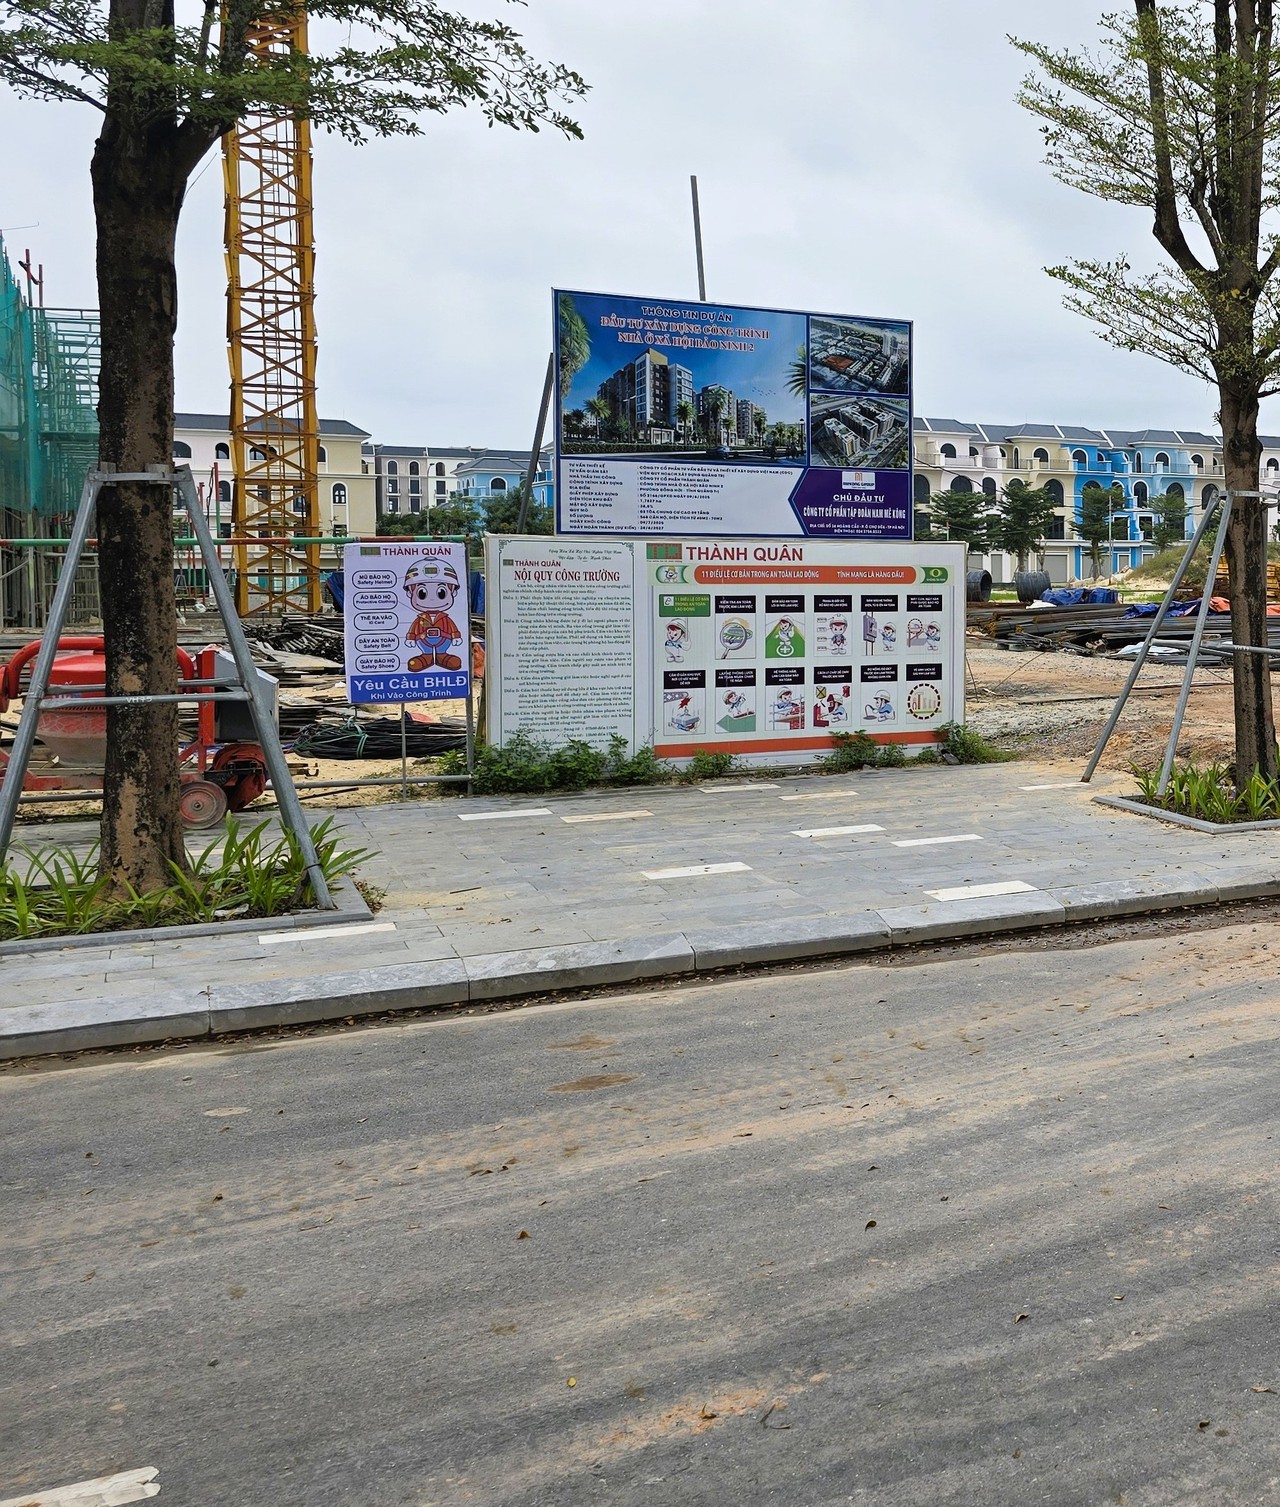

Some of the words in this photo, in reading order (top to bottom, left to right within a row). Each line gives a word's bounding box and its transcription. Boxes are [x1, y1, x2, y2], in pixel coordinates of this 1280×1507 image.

[642, 306, 680, 318] THÔNG
[682, 310, 698, 319] TIN
[701, 312, 716, 323] DỰ
[718, 311, 732, 322] ÁN
[601, 313, 626, 328] ĐẦU
[627, 318, 643, 329] TƯ
[645, 320, 668, 331] XÂY
[669, 322, 701, 335] DỰNG
[703, 324, 734, 336] CÔNG
[736, 327, 770, 339] TRÌNH
[618, 331, 644, 343] NHÀ
[645, 331, 654, 344] Ở
[655, 334, 671, 345] XÃ
[672, 335, 694, 349] HỘI
[696, 337, 718, 348] BẢO
[720, 340, 747, 351] NINH
[748, 343, 755, 352] 2
[833, 493, 851, 502] CHỦ
[854, 493, 872, 502] ĐẦU
[803, 505, 817, 516] CÔNG
[818, 508, 824, 516] TY
[826, 504, 832, 517] CỔ
[833, 505, 847, 517] PHẦN
[848, 507, 857, 519] TẬP
[858, 506, 871, 518] ĐOÀN
[872, 509, 883, 518] NAM
[884, 508, 891, 518] MÊ
[893, 508, 906, 518] KÔNG
[383, 546, 418, 556] THÀNH
[422, 546, 451, 556] QUÂN
[686, 543, 747, 560] THÀNH
[753, 544, 803, 561] QUÂN
[514, 568, 531, 583] NỘI
[534, 571, 553, 582] QUY
[555, 569, 580, 581] CÔNG
[583, 569, 620, 581] TRƯỜNG
[709, 569, 722, 578] ĐIỀU
[724, 570, 730, 579] LỆ
[739, 569, 750, 578] BẢN
[804, 570, 819, 579] ĐỘNG
[354, 680, 384, 691] Yêu
[389, 676, 419, 689] Cầu
[424, 676, 467, 687] BHLĐ
